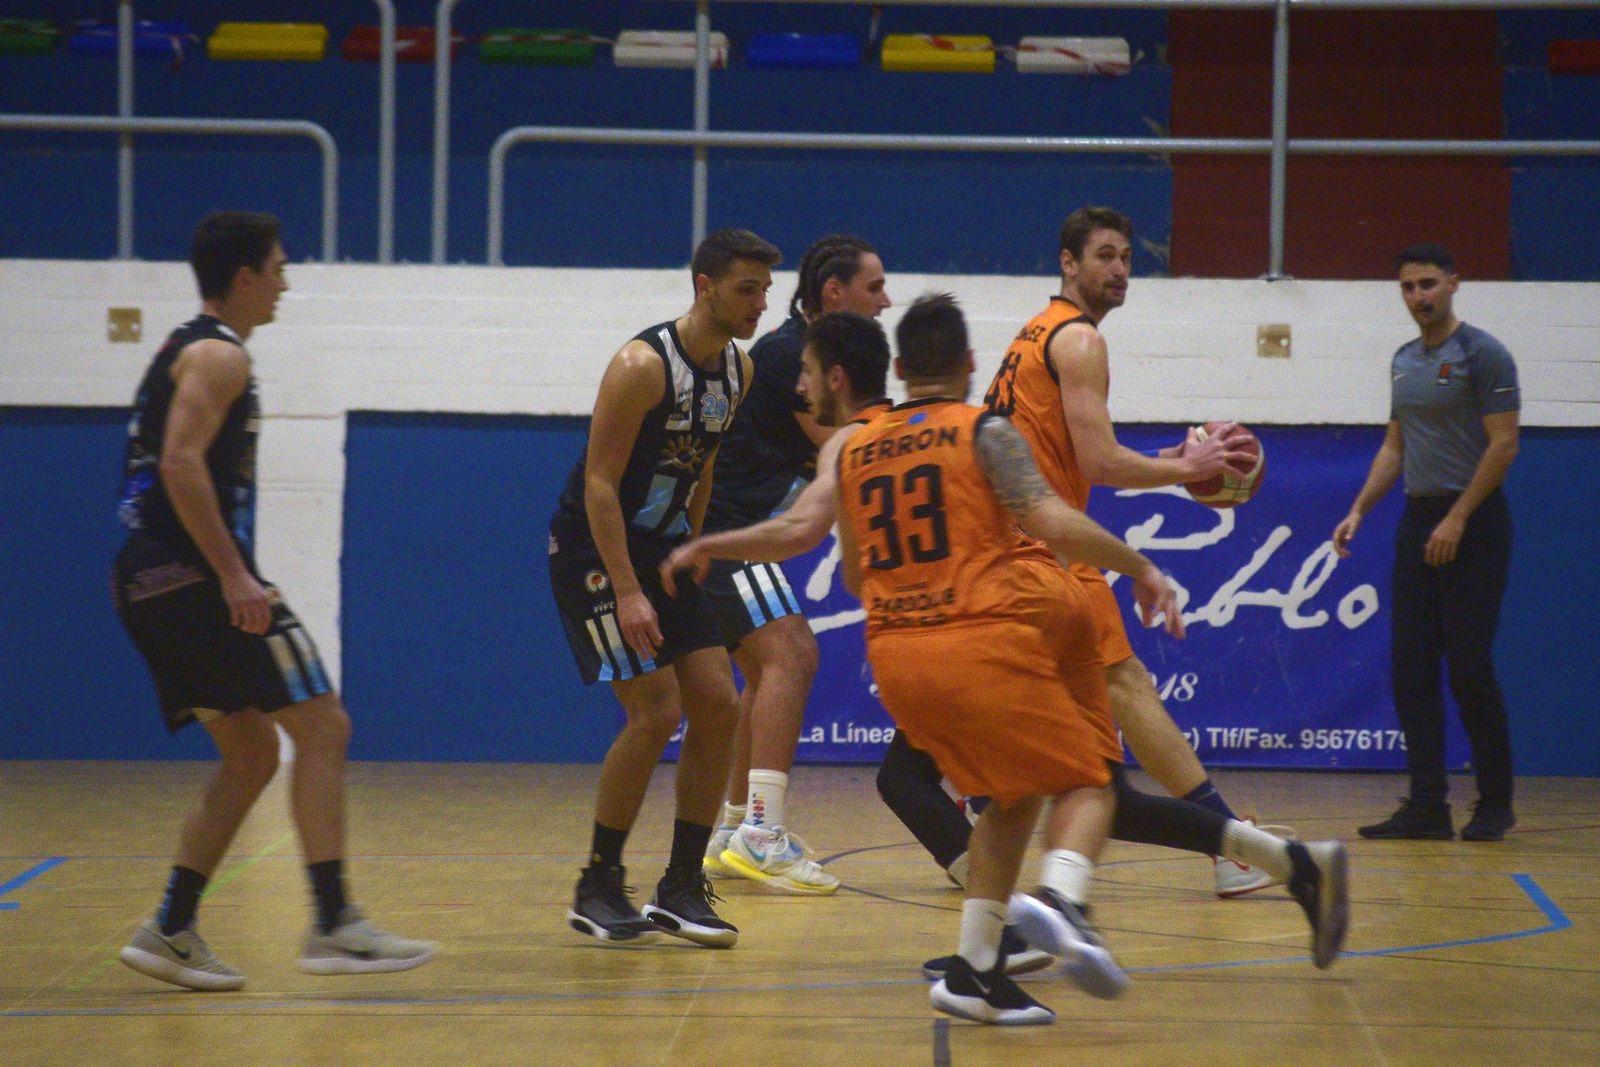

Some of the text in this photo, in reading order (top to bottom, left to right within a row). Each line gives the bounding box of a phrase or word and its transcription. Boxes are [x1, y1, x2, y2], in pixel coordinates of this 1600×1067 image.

[849, 426, 960, 470] TERRON
[860, 463, 951, 570] 33
[832, 722, 896, 744] Línea
[1206, 727, 1294, 749] Tlf/Fax.
